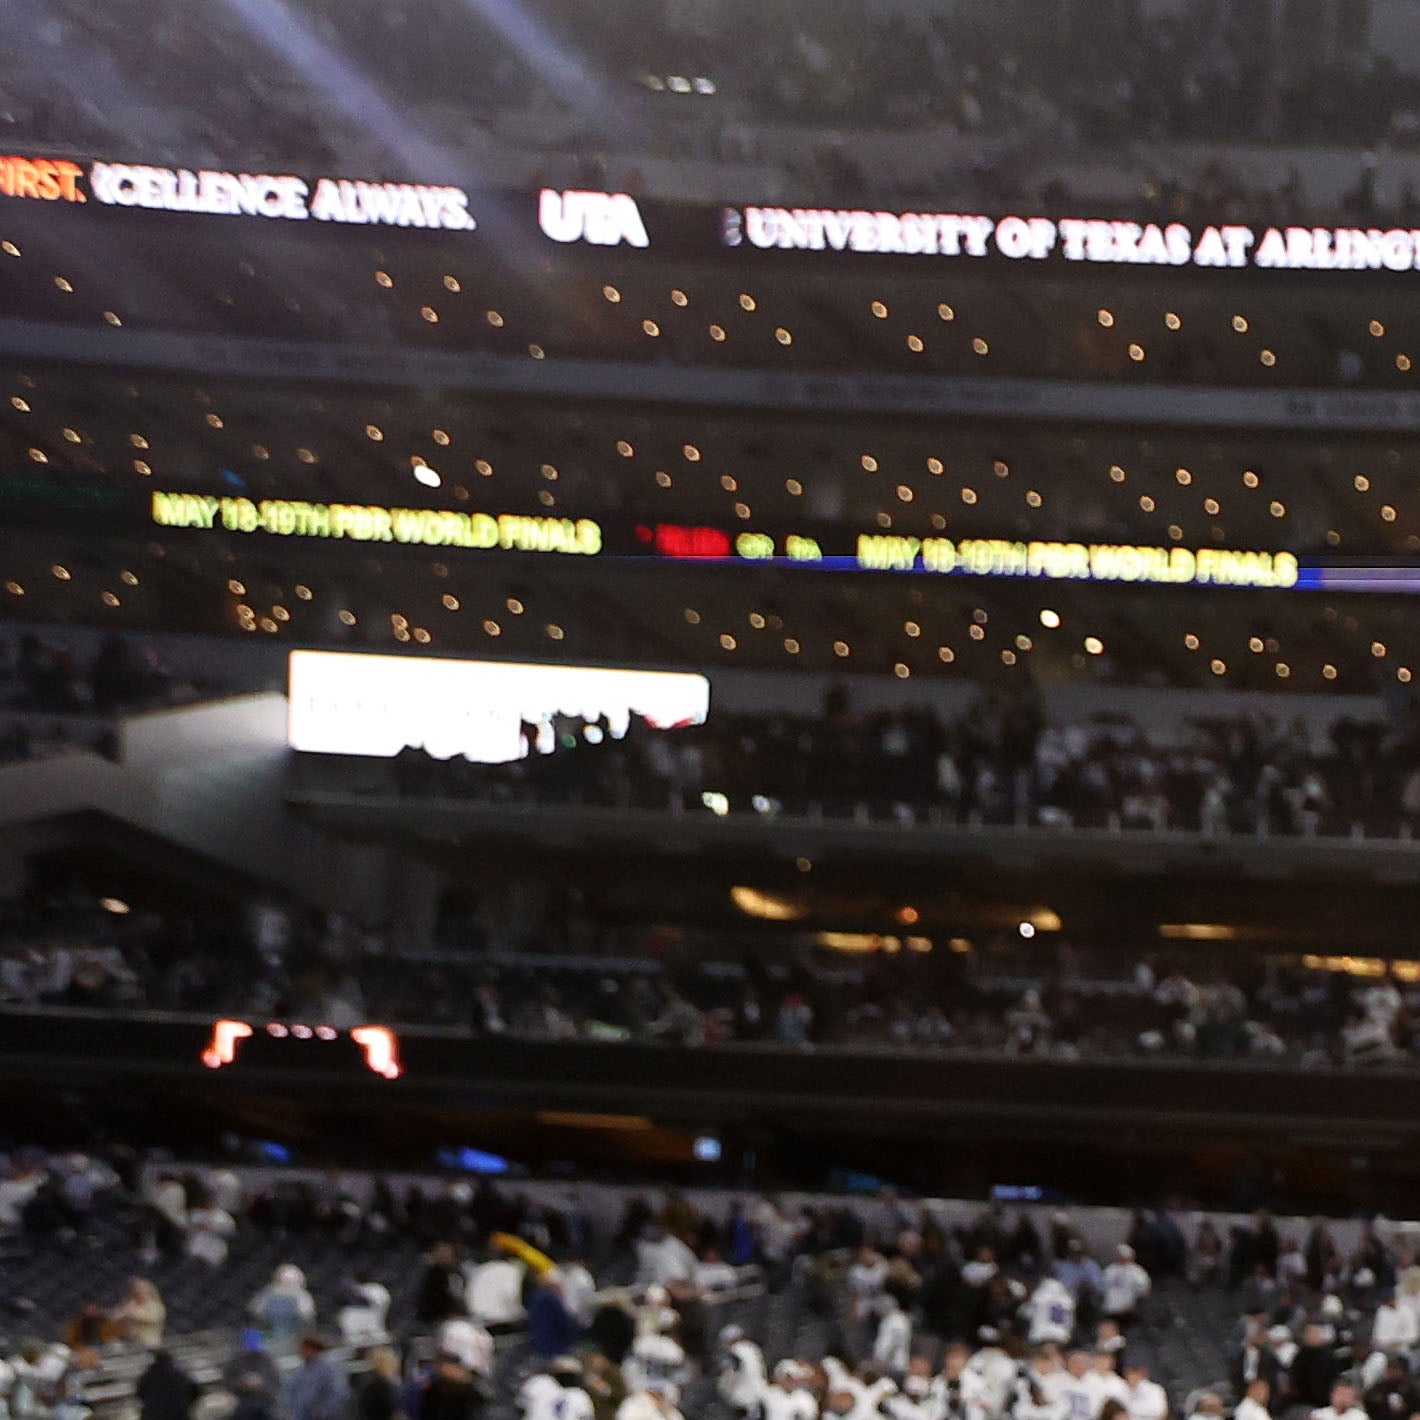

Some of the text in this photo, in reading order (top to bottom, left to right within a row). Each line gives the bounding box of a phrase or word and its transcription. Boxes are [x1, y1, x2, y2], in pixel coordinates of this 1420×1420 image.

[311, 178, 477, 231] ALWAYS.
[539, 188, 650, 248] UTA
[745, 205, 994, 256] UNIVERSITY
[997, 215, 1056, 259] OF
[1059, 218, 1191, 266] TEXAS
[1194, 226, 1254, 267] AT
[152, 491, 219, 529] MAY
[391, 506, 500, 549] WORLD
[500, 512, 602, 555] FINALS
[857, 534, 921, 570] MAY
[1089, 543, 1196, 583] WORLD
[1196, 548, 1298, 588] FINALS
